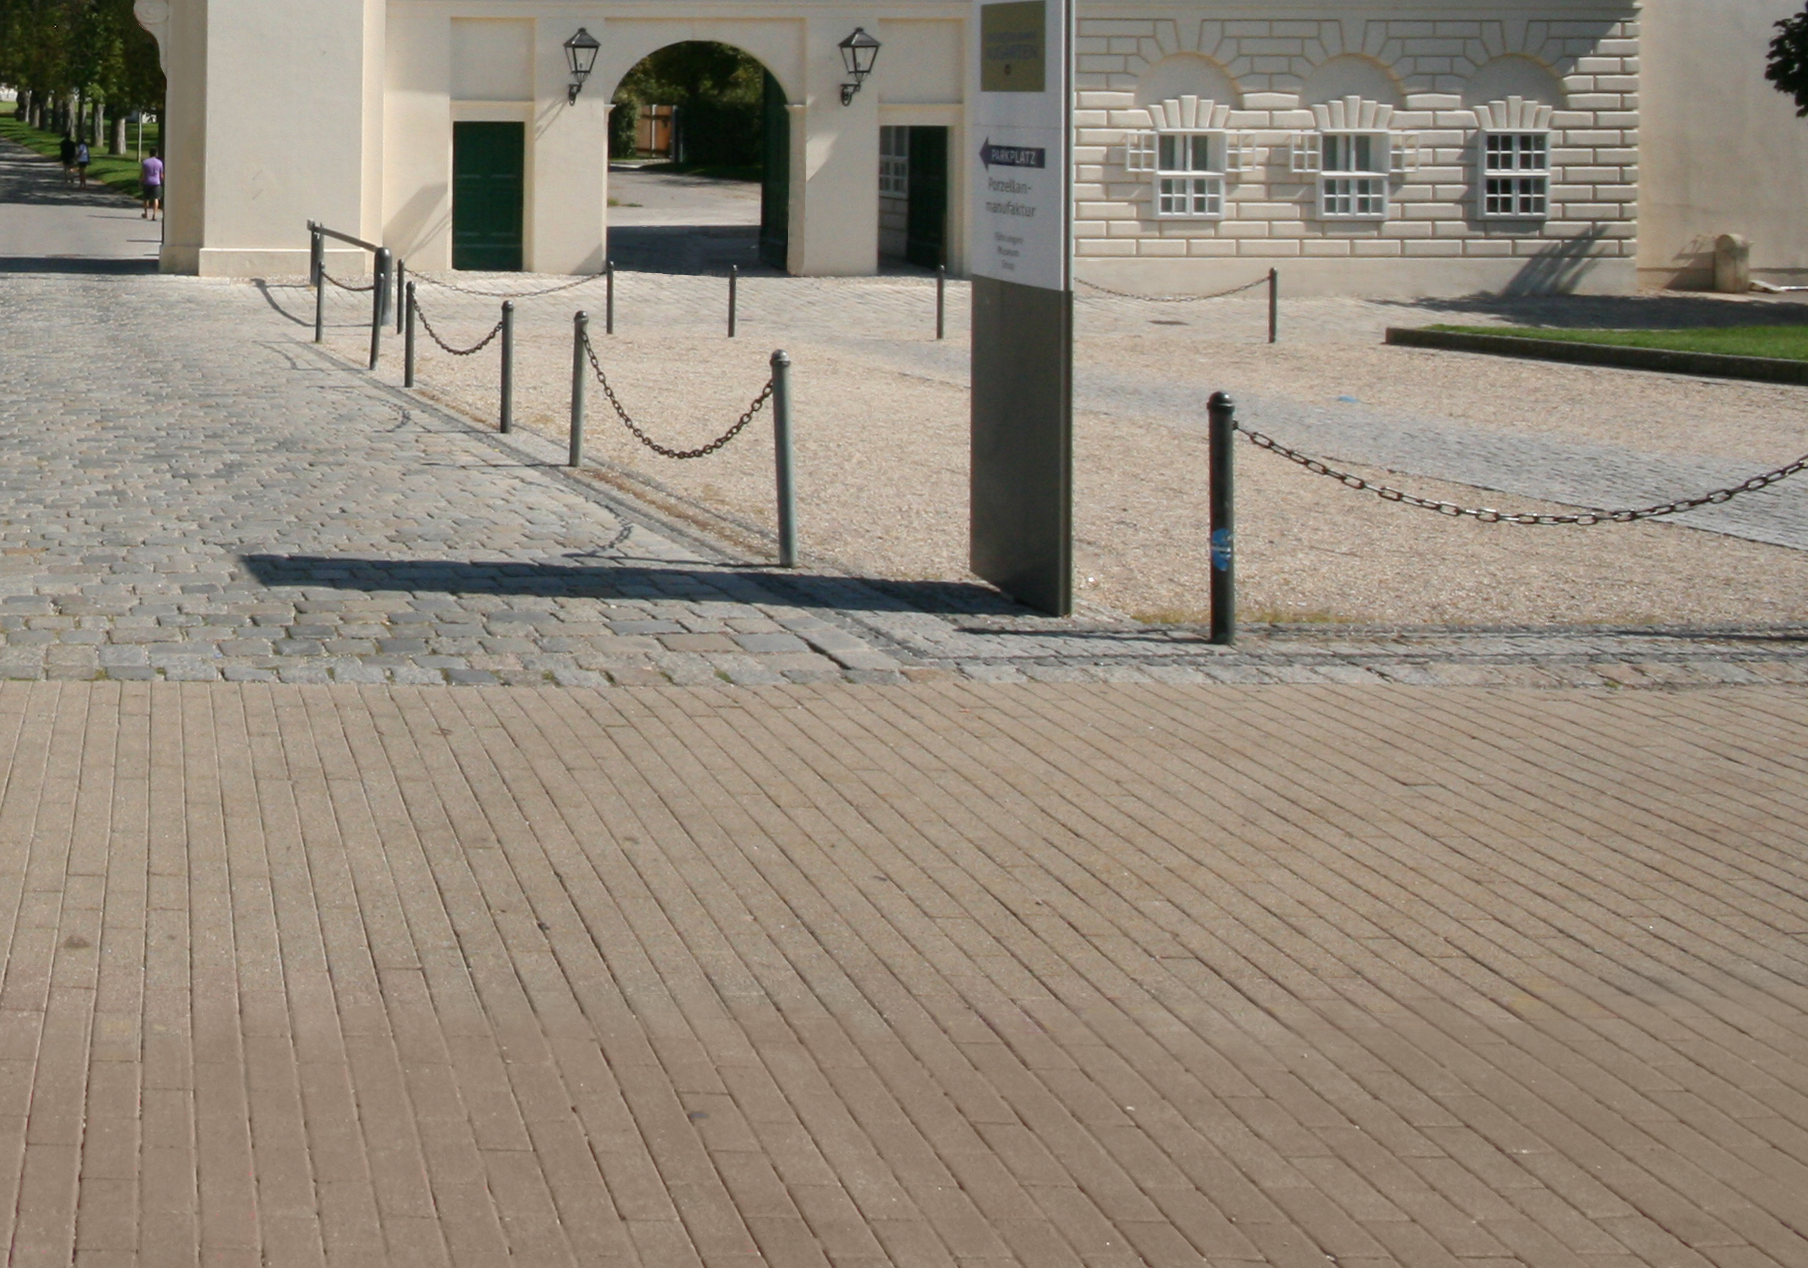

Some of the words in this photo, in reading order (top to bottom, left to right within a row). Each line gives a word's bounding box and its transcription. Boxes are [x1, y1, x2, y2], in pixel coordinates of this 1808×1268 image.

[991, 148, 1036, 165] PARKPLATZ
[988, 177, 1031, 194] Porzellan-
[985, 201, 1036, 217] manufaktur
